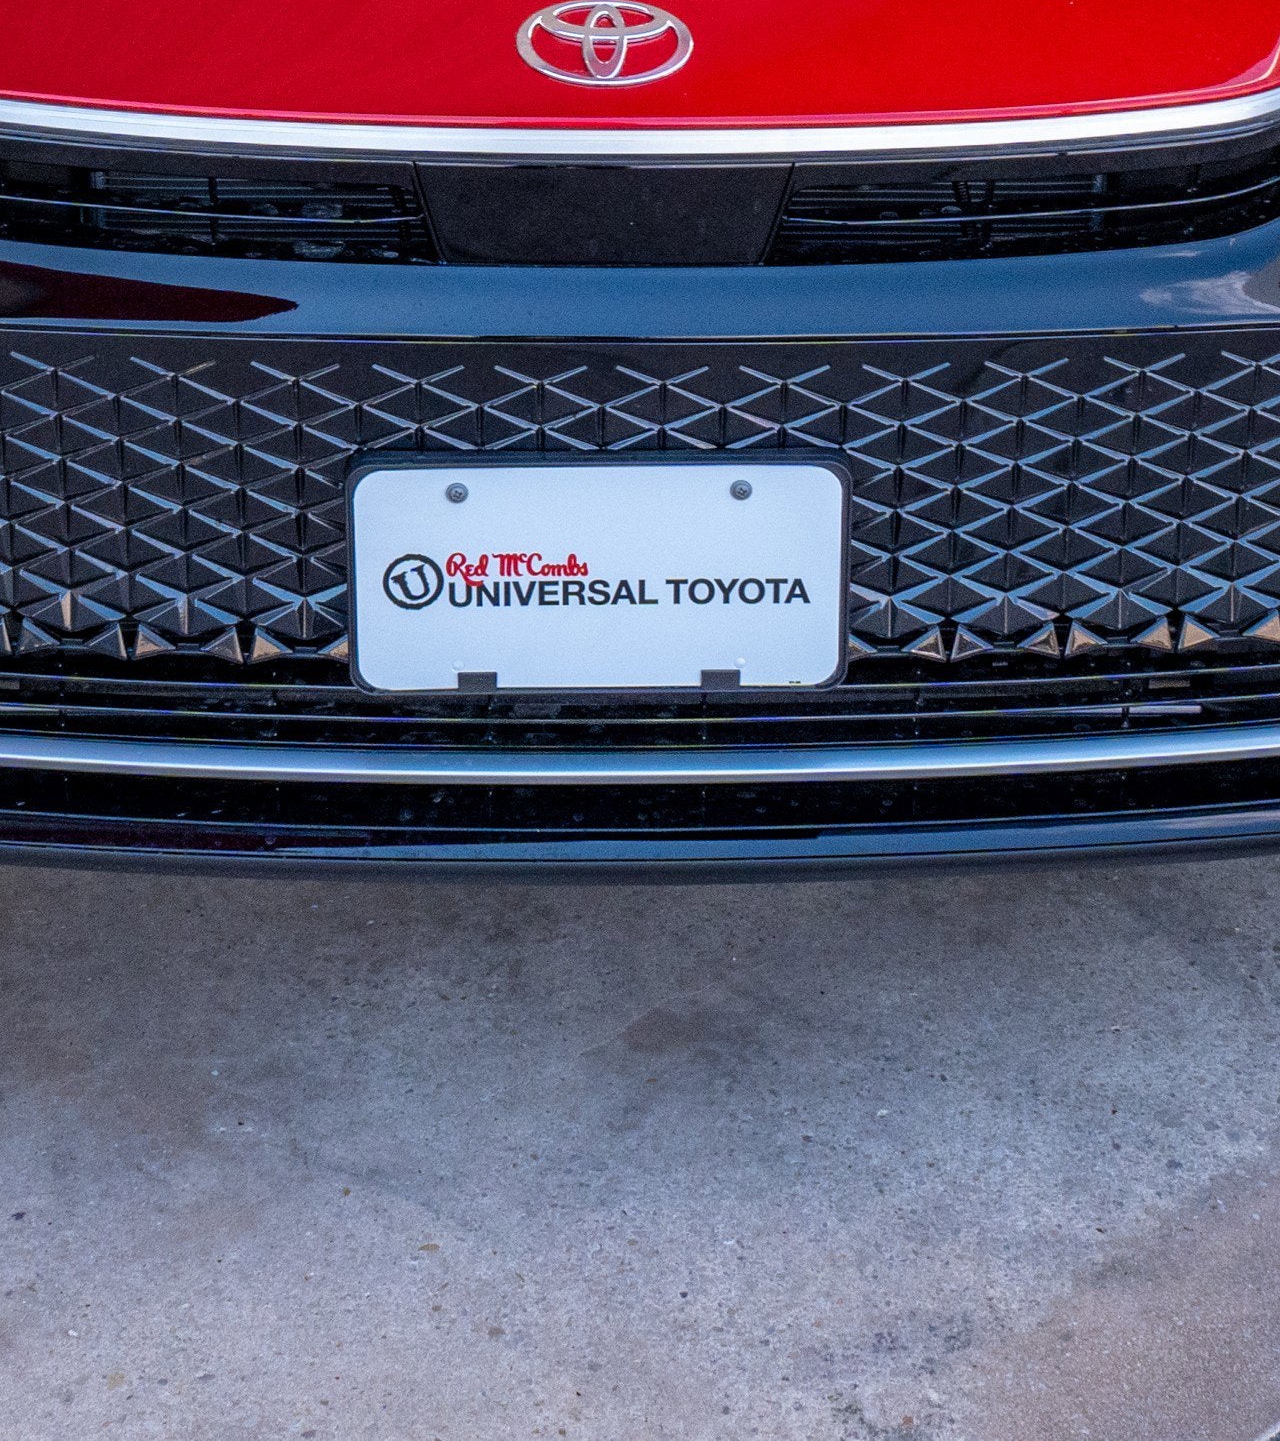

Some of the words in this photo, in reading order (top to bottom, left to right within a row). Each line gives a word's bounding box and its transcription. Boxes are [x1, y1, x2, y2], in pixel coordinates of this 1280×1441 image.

[446, 552, 489, 587] Red
[493, 552, 589, 579] McCombs
[448, 577, 659, 608] UNIVERSAL
[665, 577, 811, 605] TOYOTA
